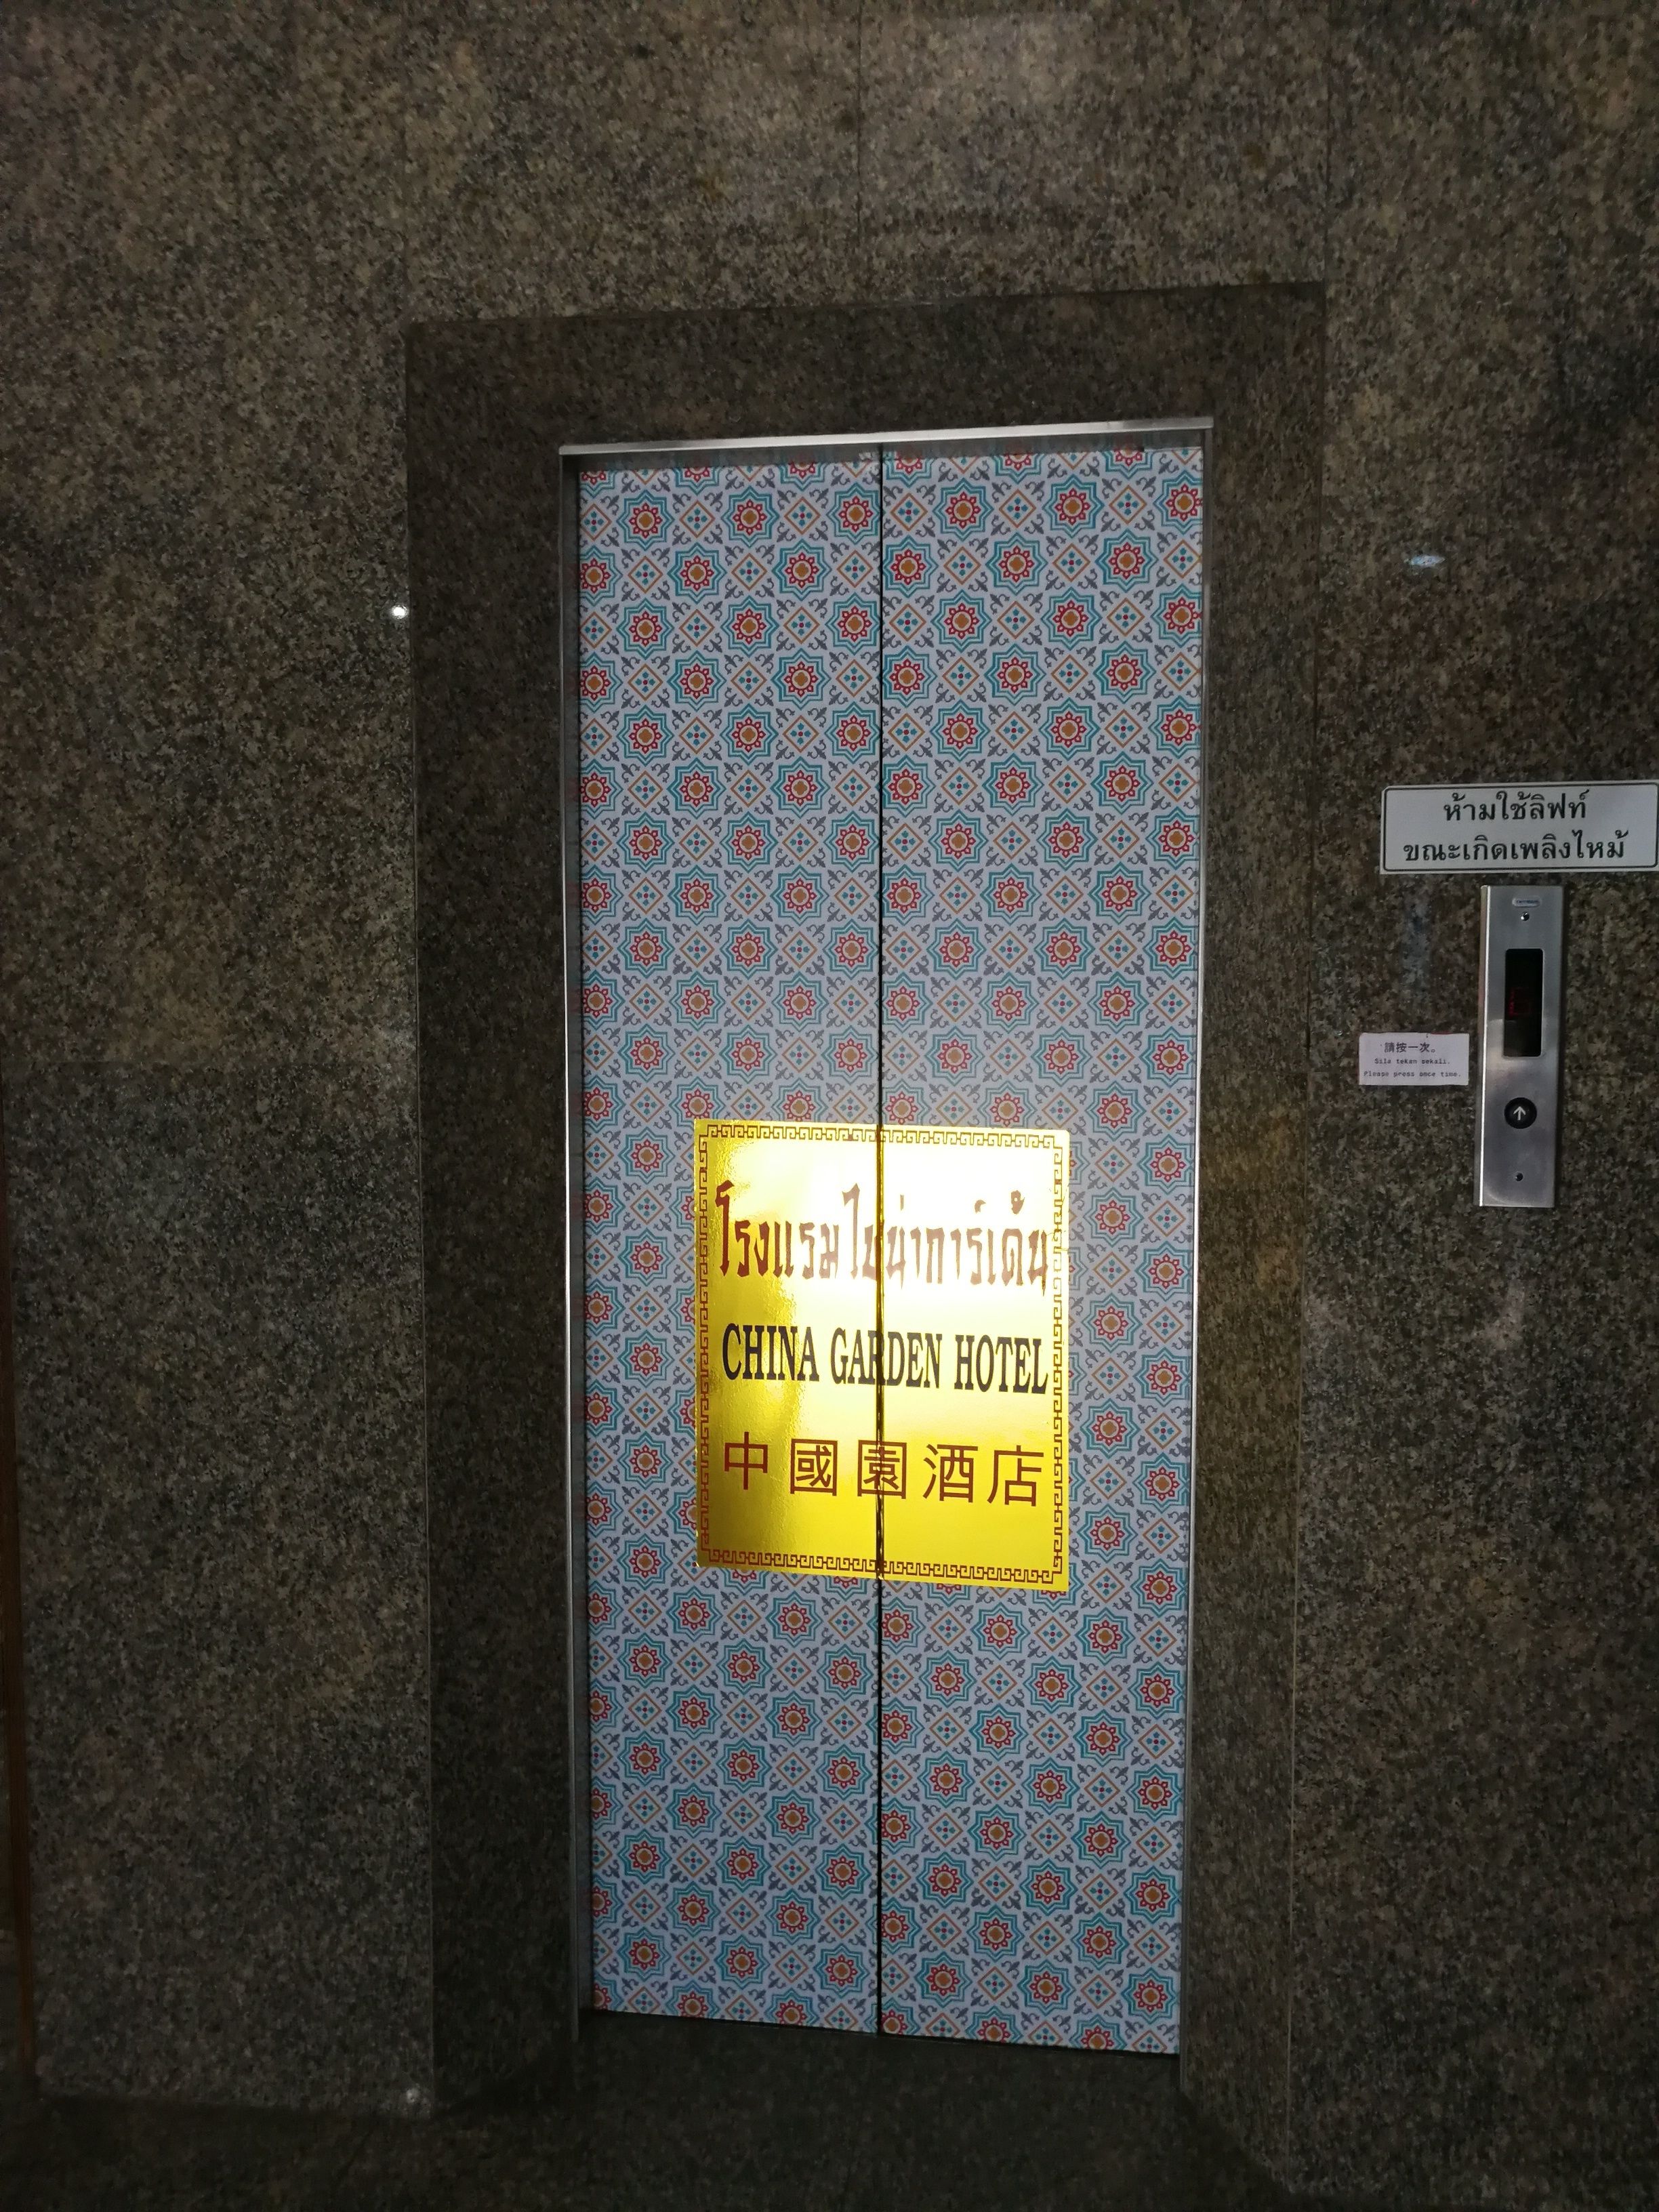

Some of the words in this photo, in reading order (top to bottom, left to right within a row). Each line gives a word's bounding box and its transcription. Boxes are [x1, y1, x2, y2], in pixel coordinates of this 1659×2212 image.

[1443, 789, 1590, 821] ห้ามใช้ลิฟท์
[1403, 830, 1629, 861] ขณะเกิดเพลิงไหม้
[722, 1324, 819, 1381] CHINA
[831, 1328, 943, 1389] GARDEN
[954, 1335, 1048, 1395] HOTEL
[723, 1431, 1044, 1507] 中國園酒店
